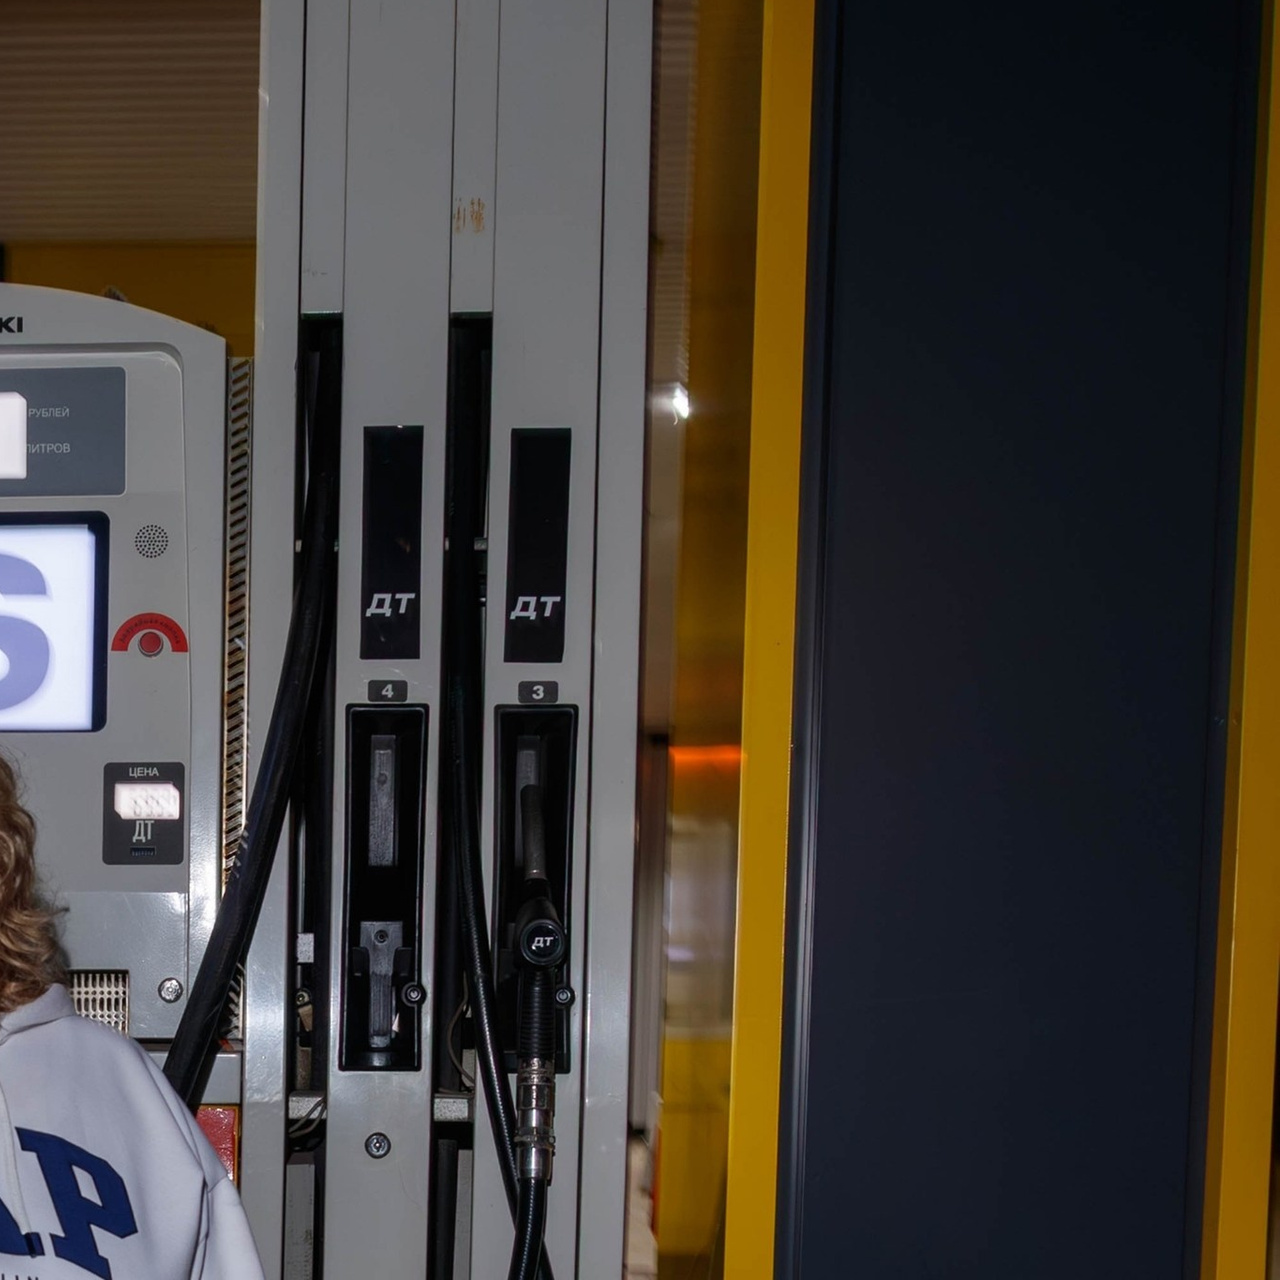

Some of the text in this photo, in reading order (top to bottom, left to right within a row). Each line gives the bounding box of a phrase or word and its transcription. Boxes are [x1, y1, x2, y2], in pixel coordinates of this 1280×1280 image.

[28, 406, 70, 418] РУБЛЕЙ
[365, 593, 416, 617] ДТ
[510, 596, 561, 620] ДТ
[381, 684, 394, 698] 4
[532, 685, 545, 699] 3
[129, 767, 159, 778] ЦЕНА
[132, 820, 155, 843] ДТ
[531, 936, 554, 950] ДТ
